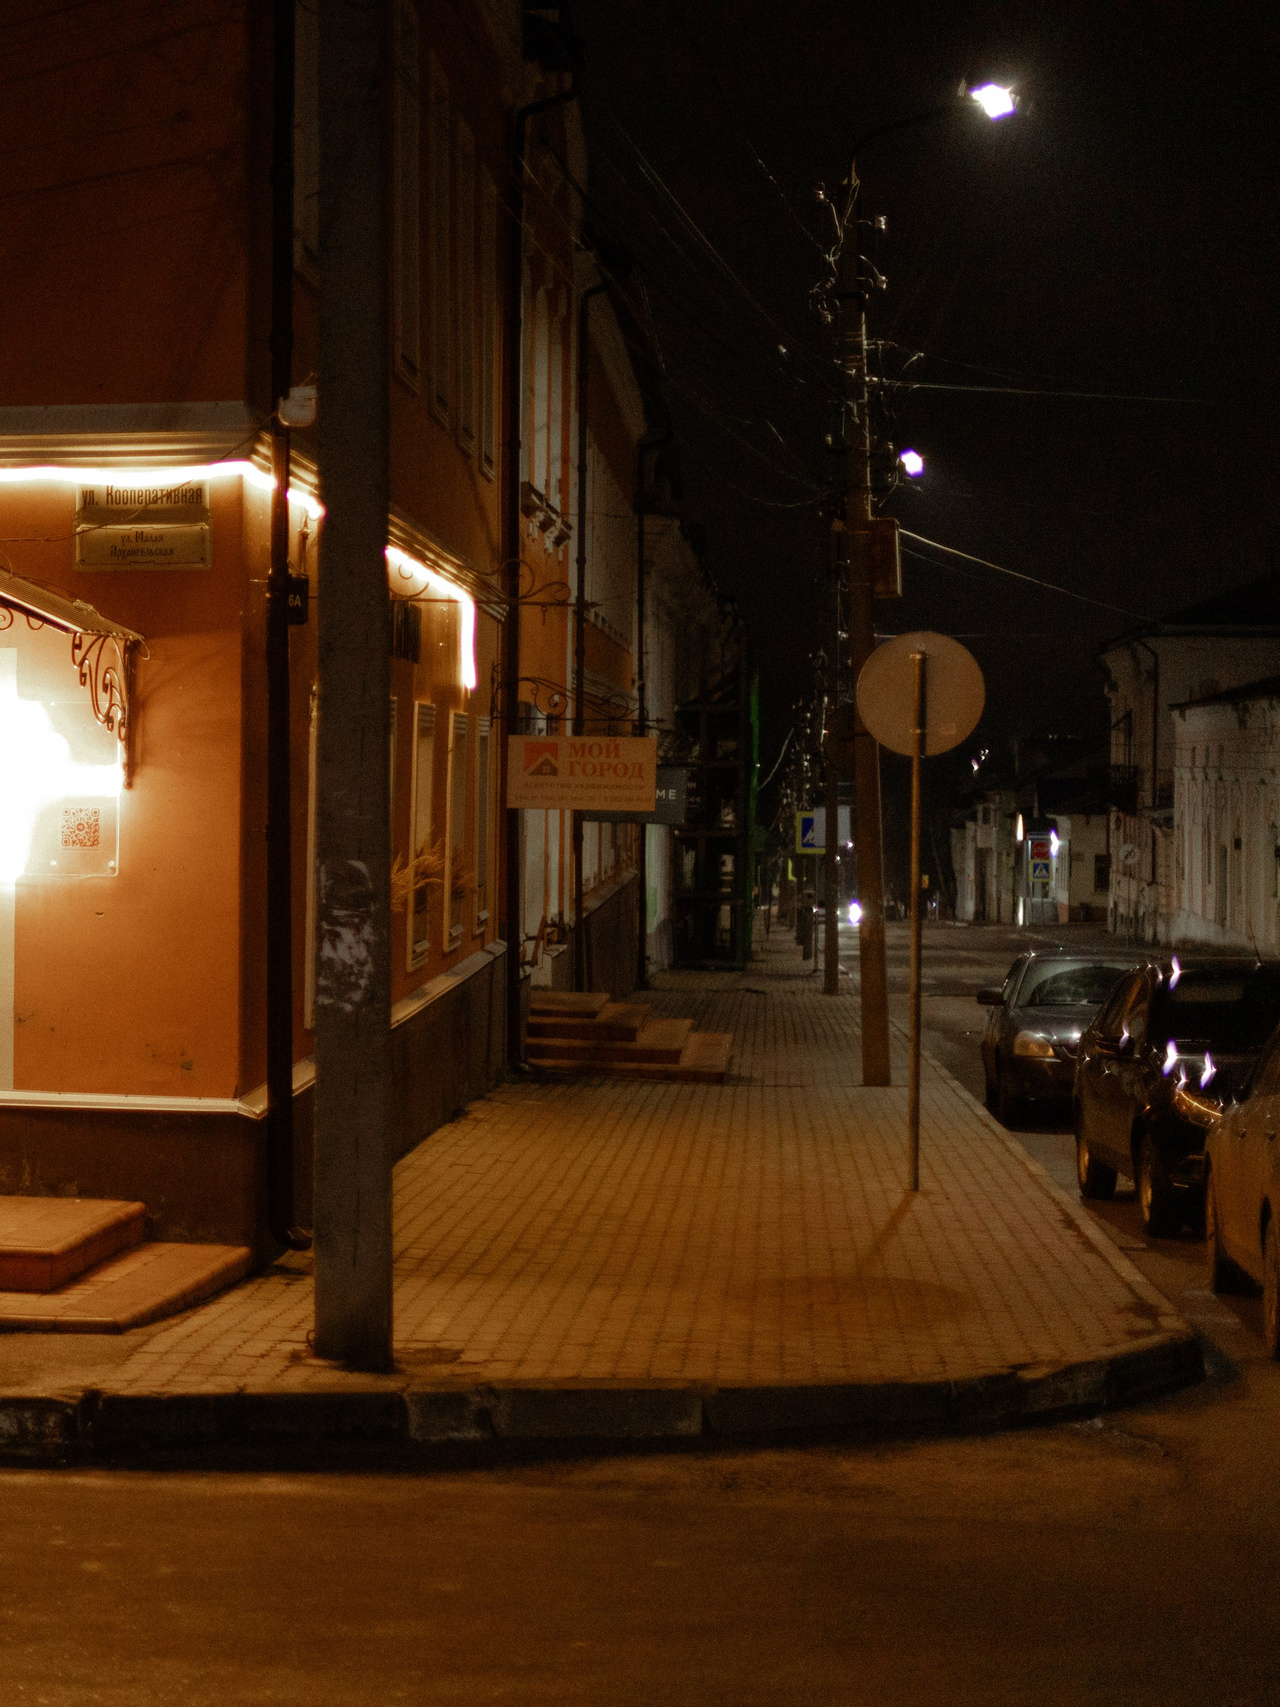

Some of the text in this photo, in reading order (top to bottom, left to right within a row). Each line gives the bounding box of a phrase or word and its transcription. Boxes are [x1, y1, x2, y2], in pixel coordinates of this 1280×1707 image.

[82, 485, 203, 511] ул. Кооперативная
[135, 531, 164, 544] Малая
[569, 738, 620, 759] МОЙ
[568, 761, 645, 782] ГОРОД
